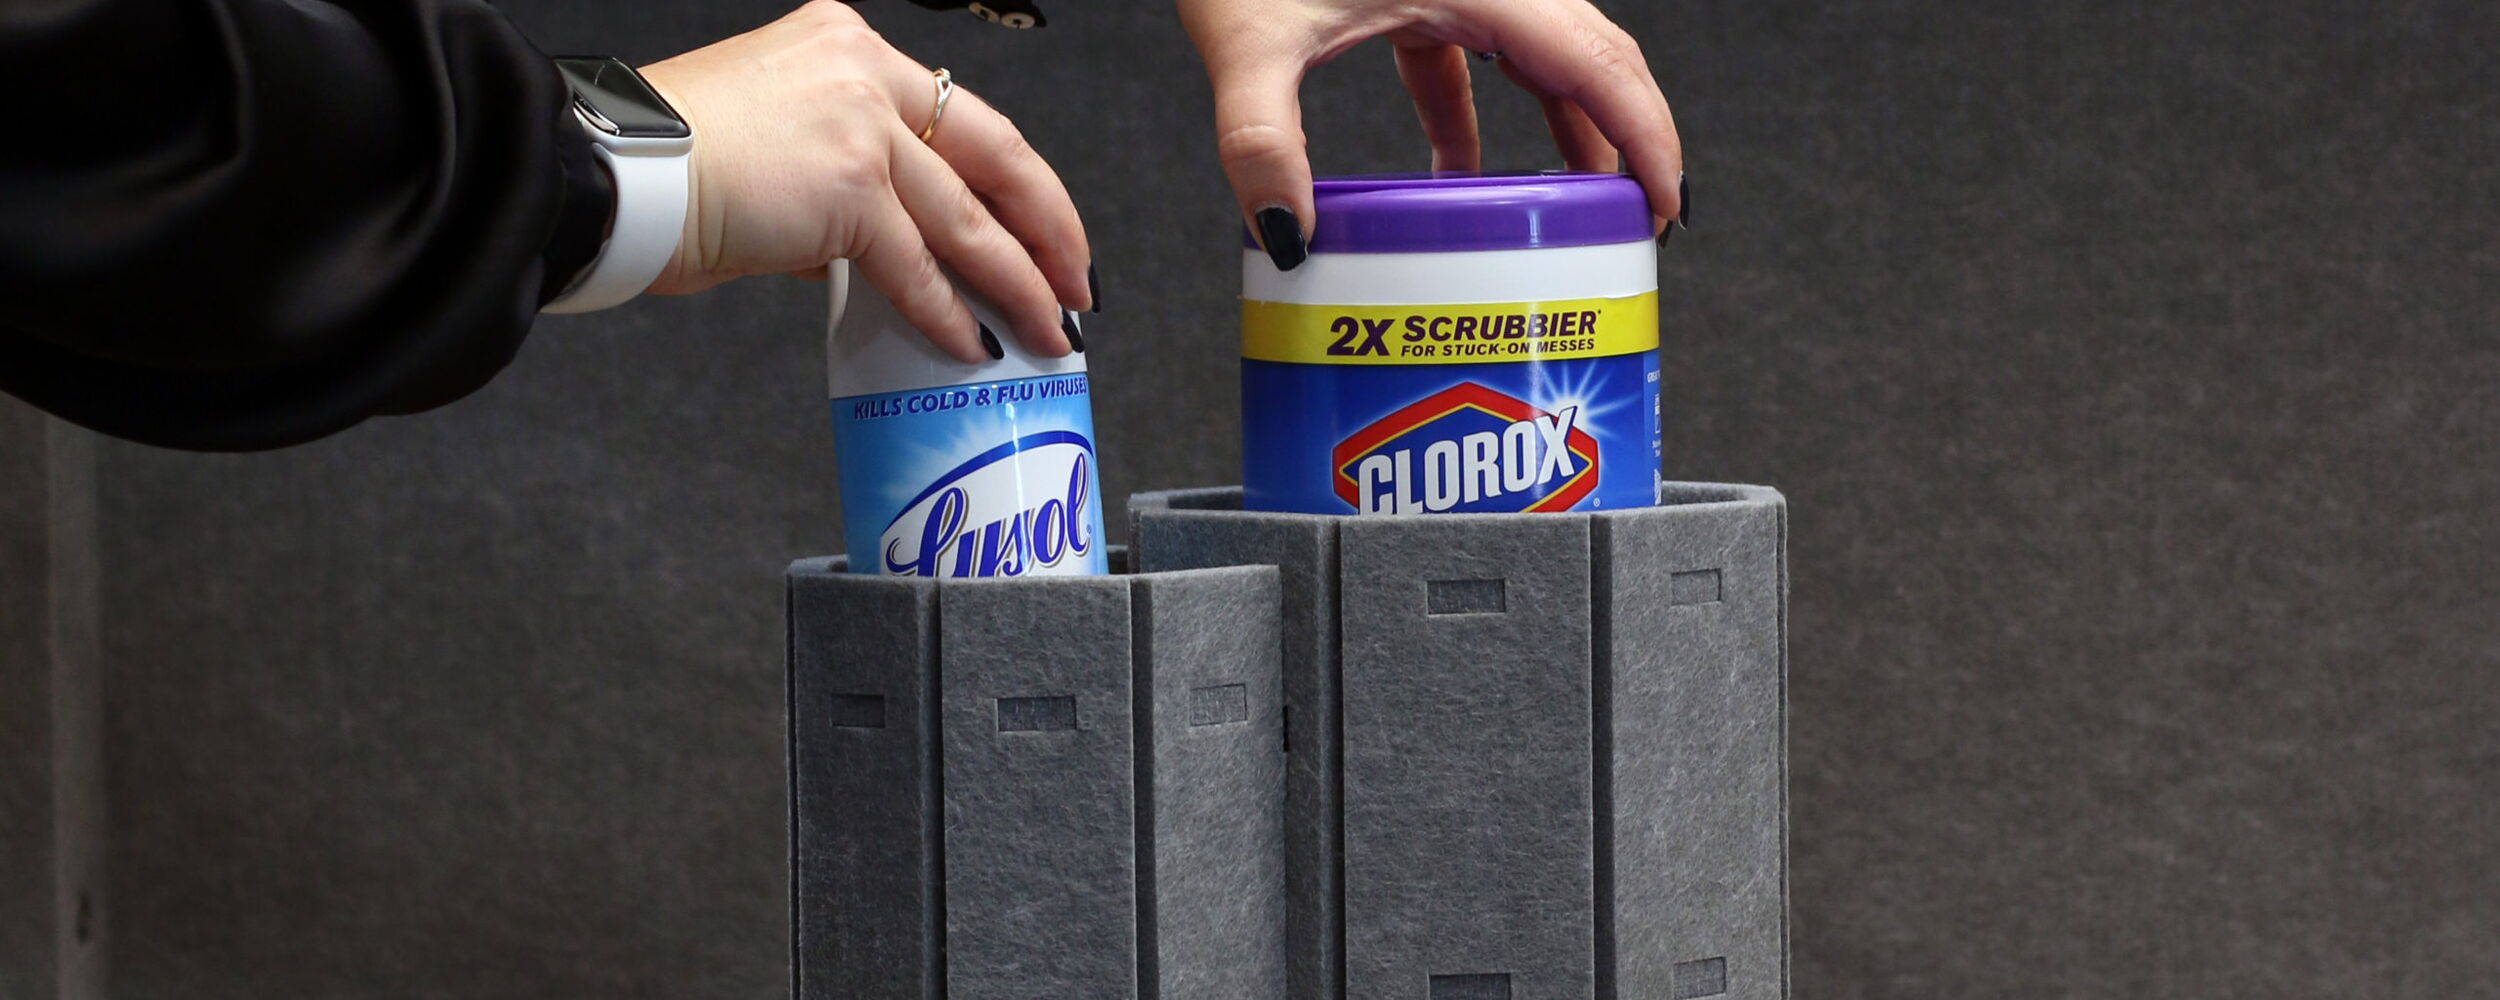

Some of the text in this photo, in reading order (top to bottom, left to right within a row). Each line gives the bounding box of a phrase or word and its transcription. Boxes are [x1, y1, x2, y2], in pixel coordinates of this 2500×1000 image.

[1327, 316, 1395, 356] 2X
[1401, 338, 1594, 357] FOR STUCK-ON MESSES
[854, 398, 903, 419] KILLS
[907, 391, 969, 413] COLD
[975, 388, 991, 406] &
[997, 383, 1034, 403] FLU
[1358, 406, 1578, 514] CLOROX
